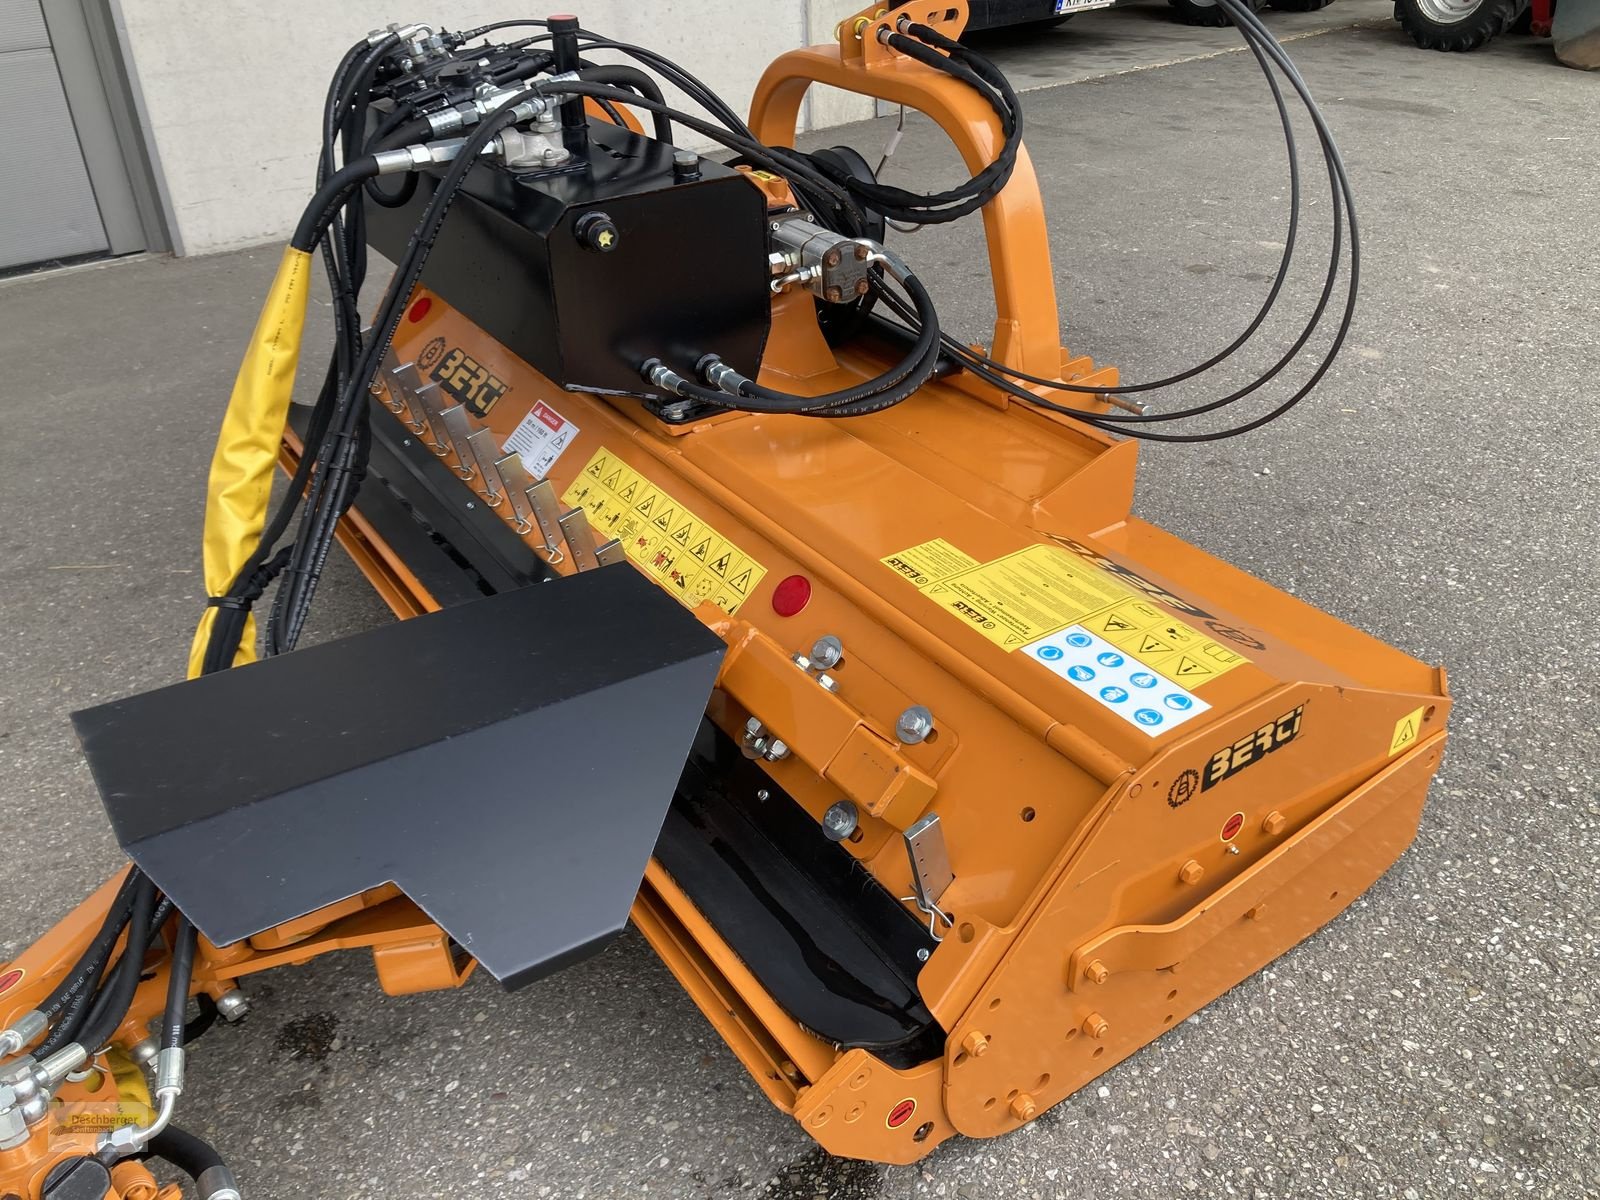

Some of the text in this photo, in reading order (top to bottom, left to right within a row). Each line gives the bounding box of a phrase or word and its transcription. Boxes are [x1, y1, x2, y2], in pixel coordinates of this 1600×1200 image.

[431, 348, 508, 418] BERTI
[952, 601, 988, 623] BERTI
[1202, 704, 1304, 793] BERTI
